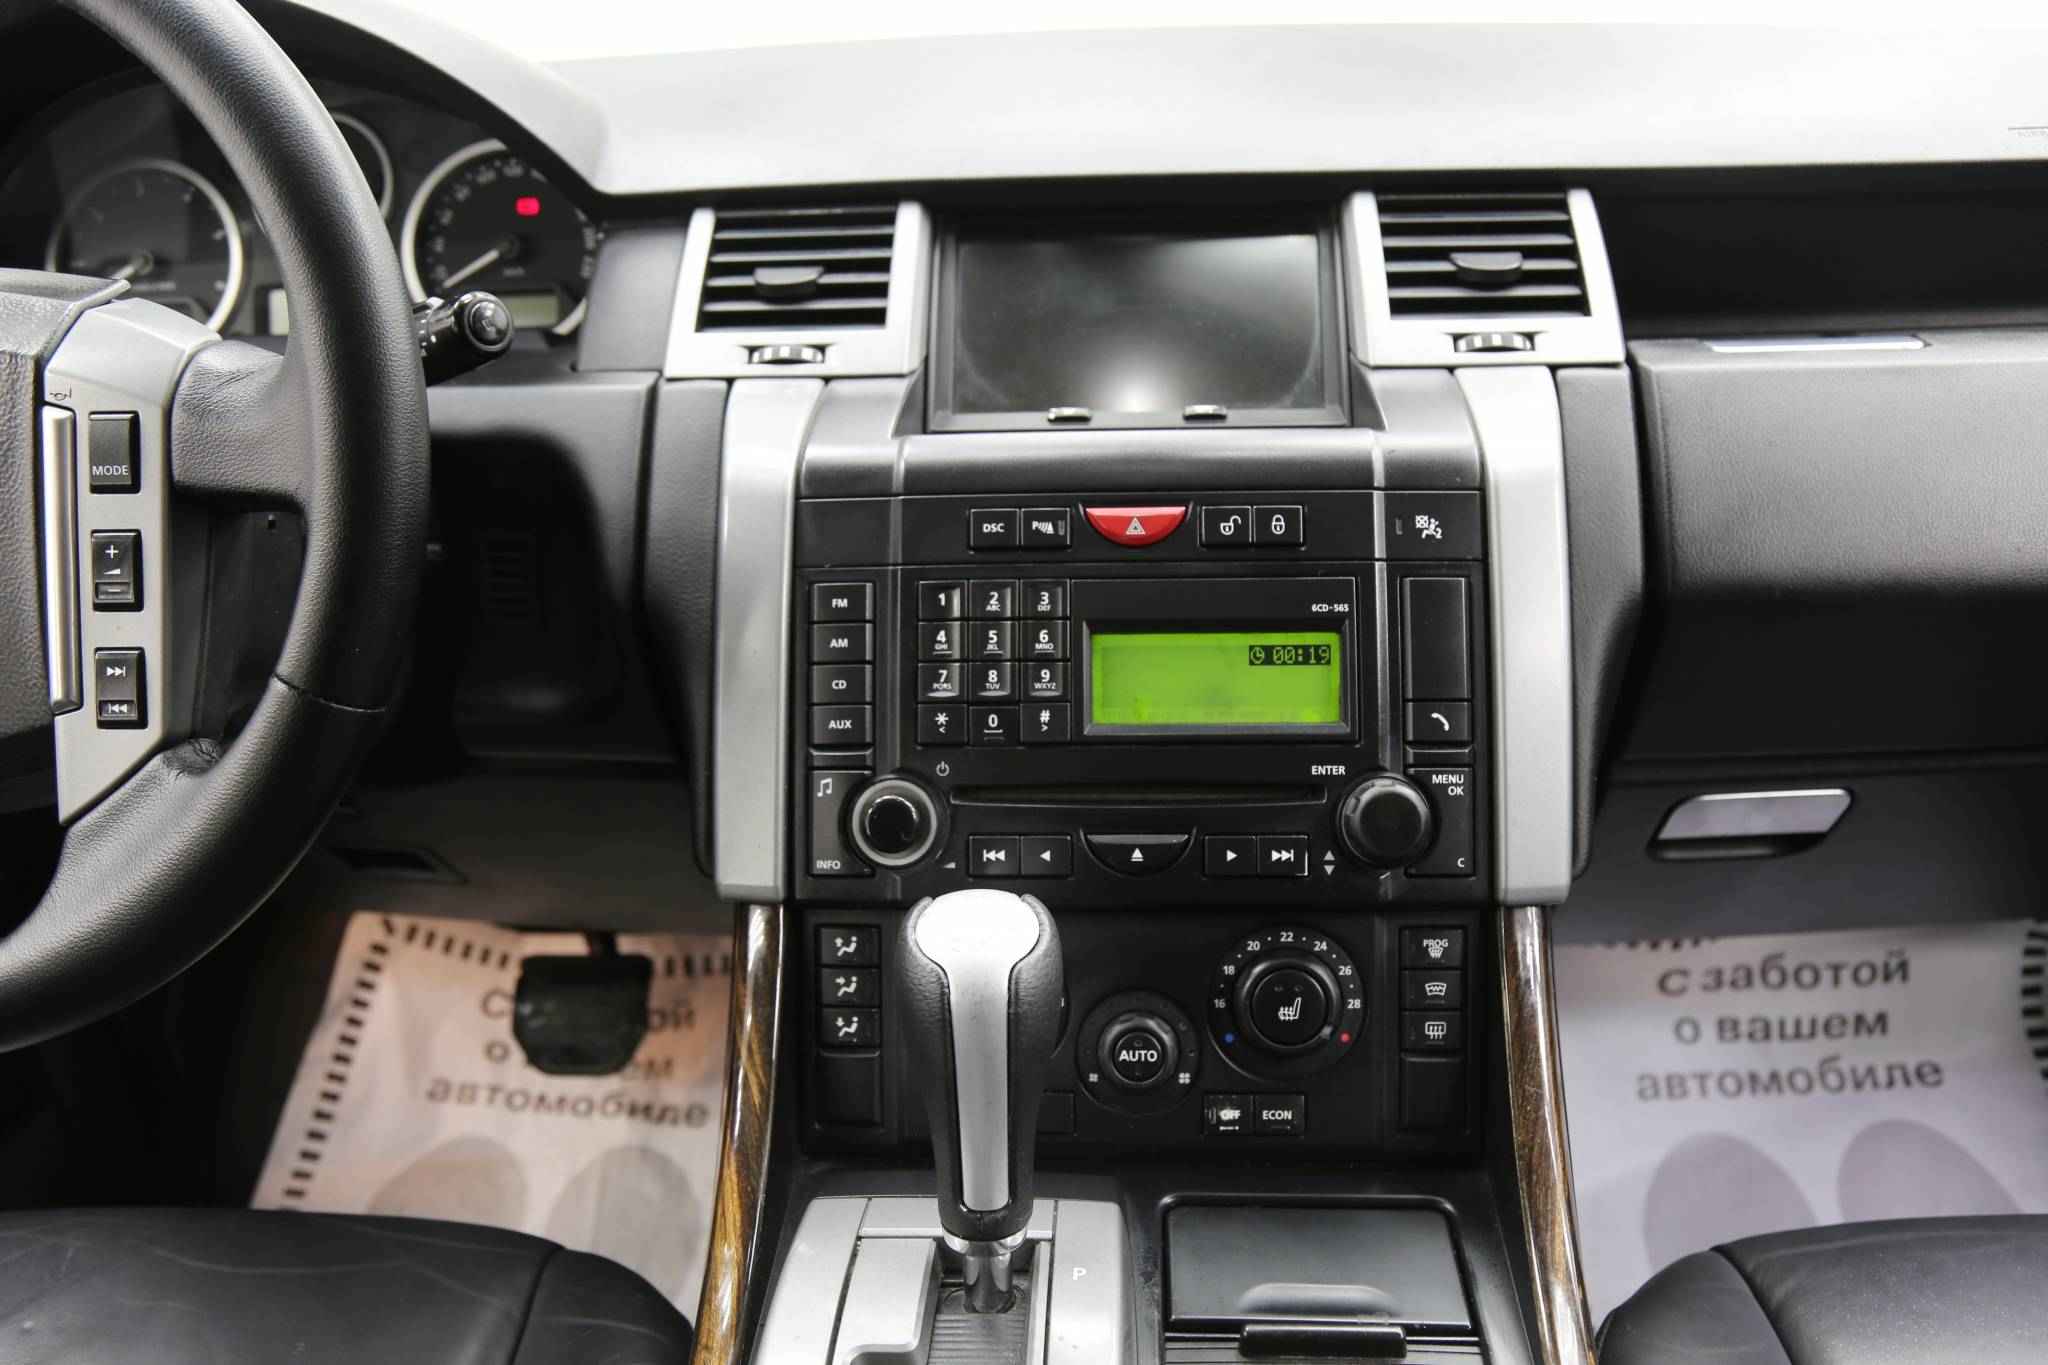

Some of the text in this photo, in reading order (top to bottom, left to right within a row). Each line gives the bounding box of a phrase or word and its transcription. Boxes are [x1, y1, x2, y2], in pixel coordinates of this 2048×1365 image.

[92, 465, 129, 475] MODE
[983, 523, 1005, 533] DSC
[831, 598, 848, 608] FM
[938, 592, 946, 606] 1
[989, 592, 999, 604] 2
[1040, 592, 1049, 604] 3
[1311, 604, 1349, 612] 6CD-565
[936, 630, 946, 643] 4
[988, 630, 998, 643] 5
[1039, 630, 1049, 643] 6
[829, 638, 848, 648] AM
[1273, 646, 1329, 664] 00:19
[938, 669, 948, 682] 7
[988, 669, 998, 682] 8
[1040, 669, 1050, 682] 9
[831, 680, 847, 690] CD
[1034, 682, 1056, 690] WXYZ
[828, 719, 852, 729] AUX
[988, 714, 998, 727] 0
[1311, 765, 1346, 775] ENTER
[1431, 774, 1464, 785] MENU
[1447, 786, 1464, 796] OK
[816, 860, 841, 870] INFO
[1457, 858, 1465, 868] C
[1280, 932, 1294, 942] 22
[1247, 941, 1261, 951] 20
[1313, 941, 1327, 951] 24
[1423, 939, 1448, 948] PROG
[1223, 965, 1235, 975] 18
[1338, 965, 1352, 975] 26
[1701, 950, 1909, 992] заботой
[1214, 998, 1226, 1008] 16
[1347, 999, 1361, 1009] 28
[1716, 1011, 1889, 1043] вашем
[1119, 1050, 1158, 1062] AUTO
[1636, 1054, 1944, 1103] автомобиле
[424, 1077, 711, 1129] автомобиле
[1262, 1109, 1292, 1120] ECON
[1072, 1267, 1087, 1280] P
